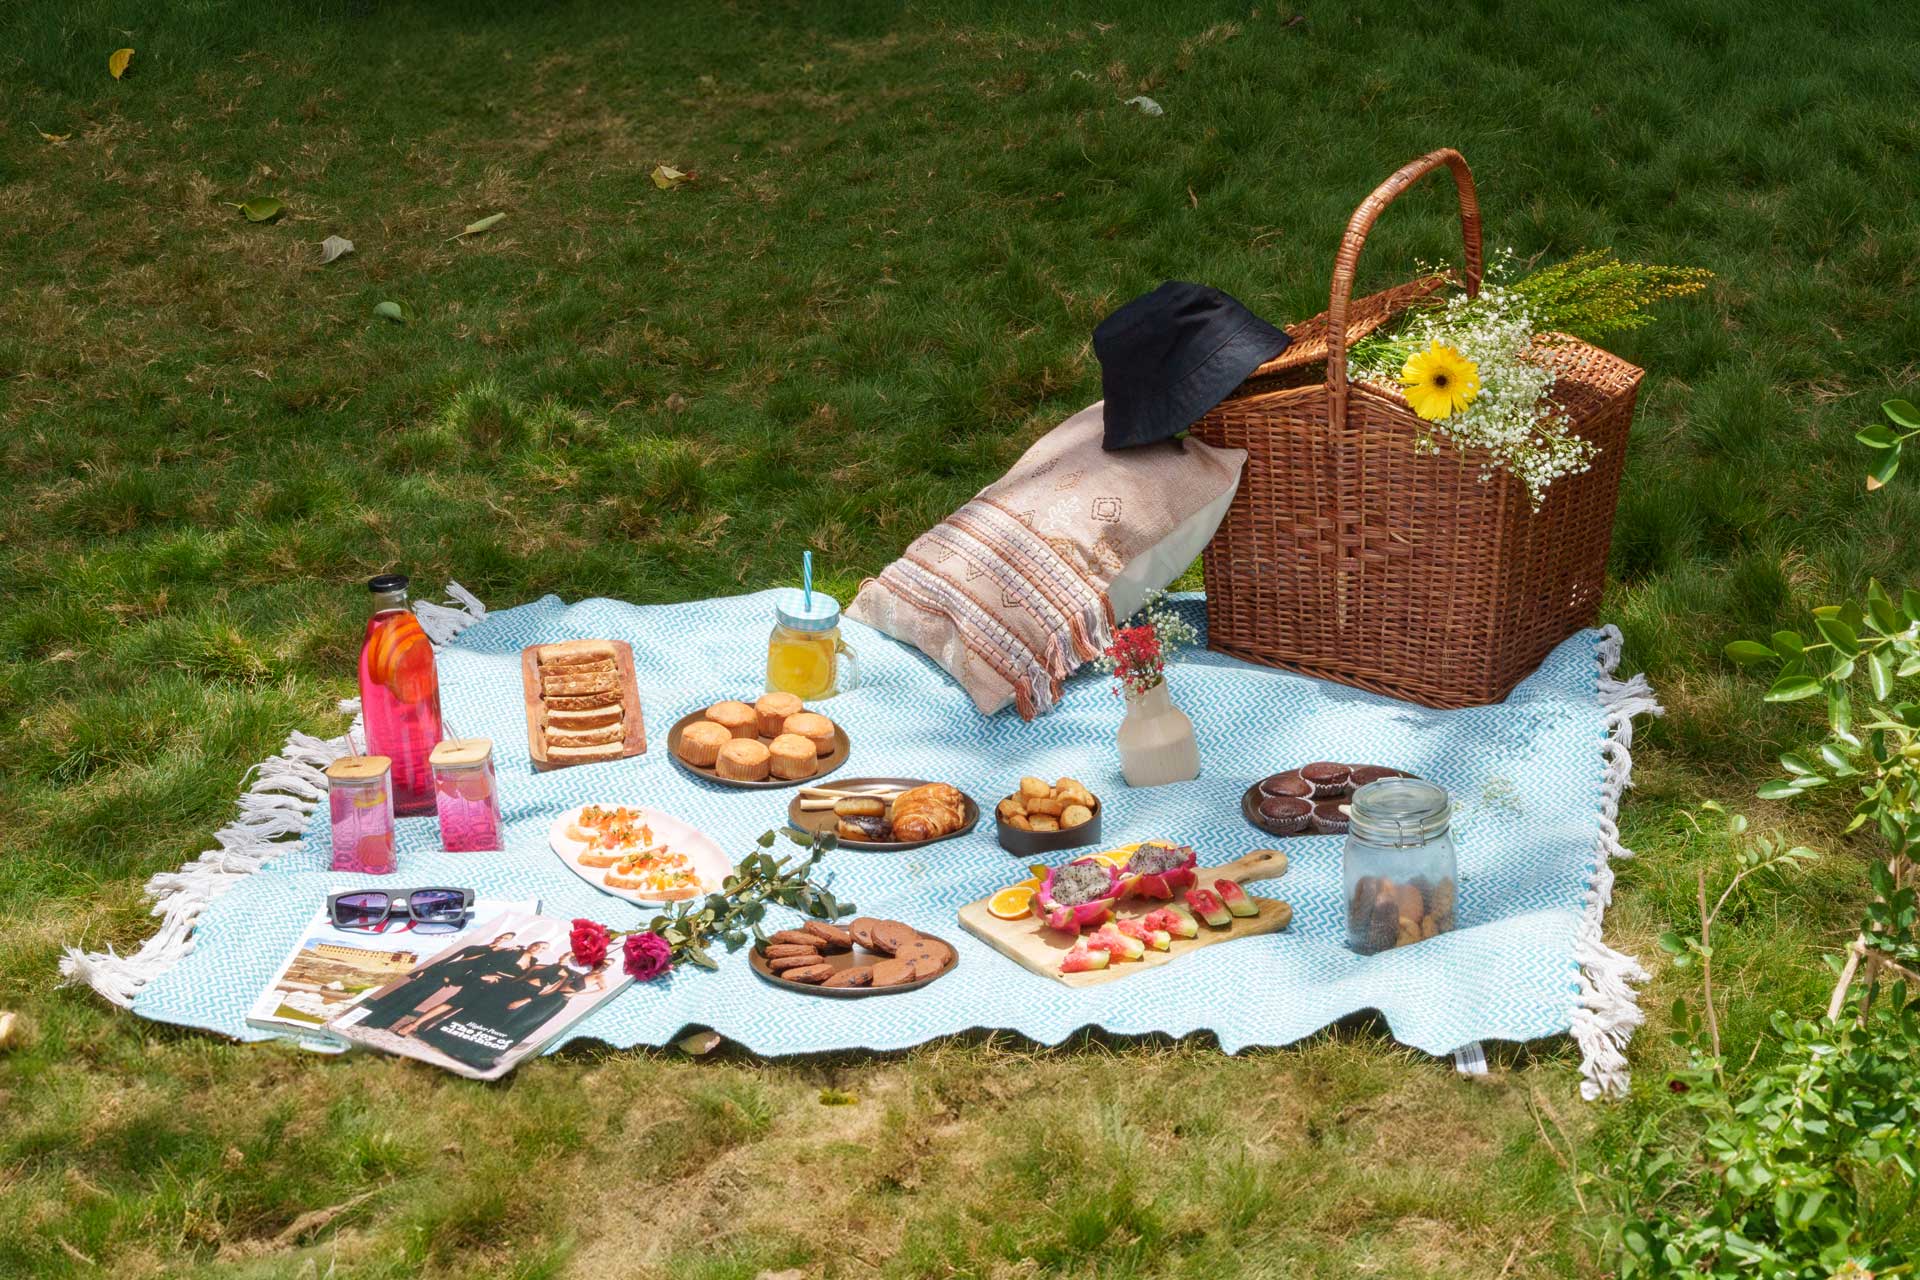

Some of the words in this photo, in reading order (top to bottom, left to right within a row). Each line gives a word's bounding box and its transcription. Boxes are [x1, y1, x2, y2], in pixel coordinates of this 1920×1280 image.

[440, 1026, 511, 1050] sisterhood
[449, 1021, 475, 1035] The
[474, 1031, 498, 1042] joy
[496, 1038, 514, 1047] of
[487, 1028, 508, 1038] Power
